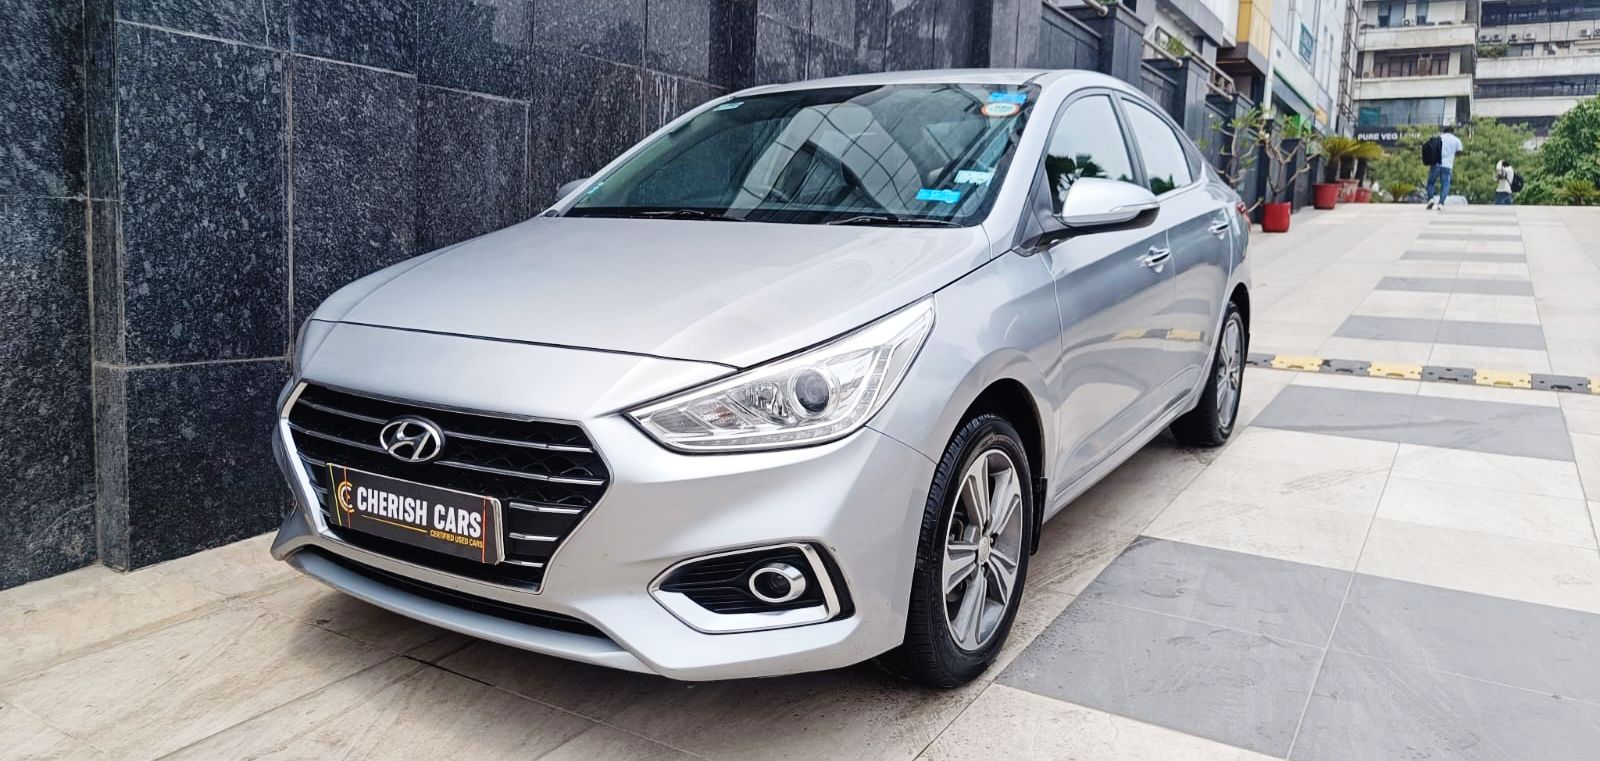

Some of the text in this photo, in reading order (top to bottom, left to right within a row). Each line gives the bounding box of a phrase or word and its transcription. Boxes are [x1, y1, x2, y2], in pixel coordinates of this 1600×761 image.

[1358, 132, 1380, 141] PURE
[357, 486, 482, 538] CHERISH CARS
[430, 529, 483, 549] CERTIFIED USED CARS
